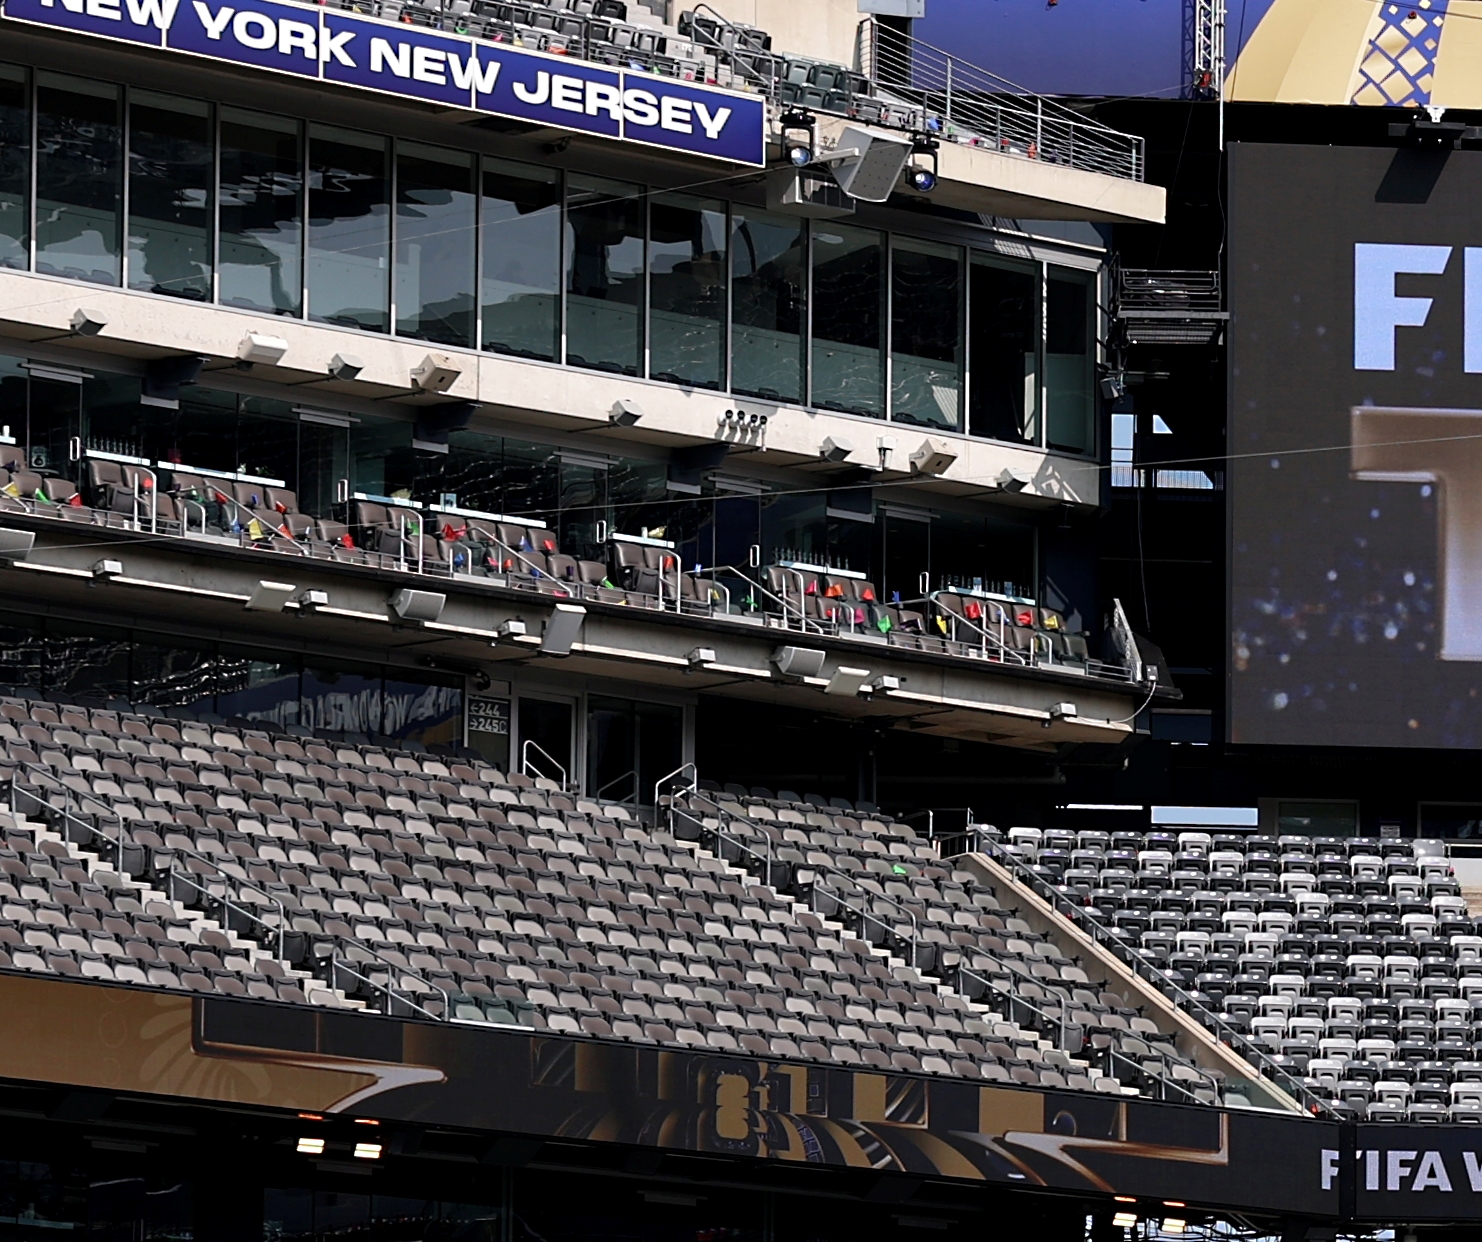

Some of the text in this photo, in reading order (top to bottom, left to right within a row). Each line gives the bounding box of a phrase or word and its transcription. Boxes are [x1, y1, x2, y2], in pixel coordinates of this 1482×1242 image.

[192, 0, 357, 68] YORK
[370, 38, 500, 95] NEW
[513, 71, 731, 139] JERSEY
[479, 703, 500, 717] 244
[1321, 1149, 1453, 1191] FIFA
